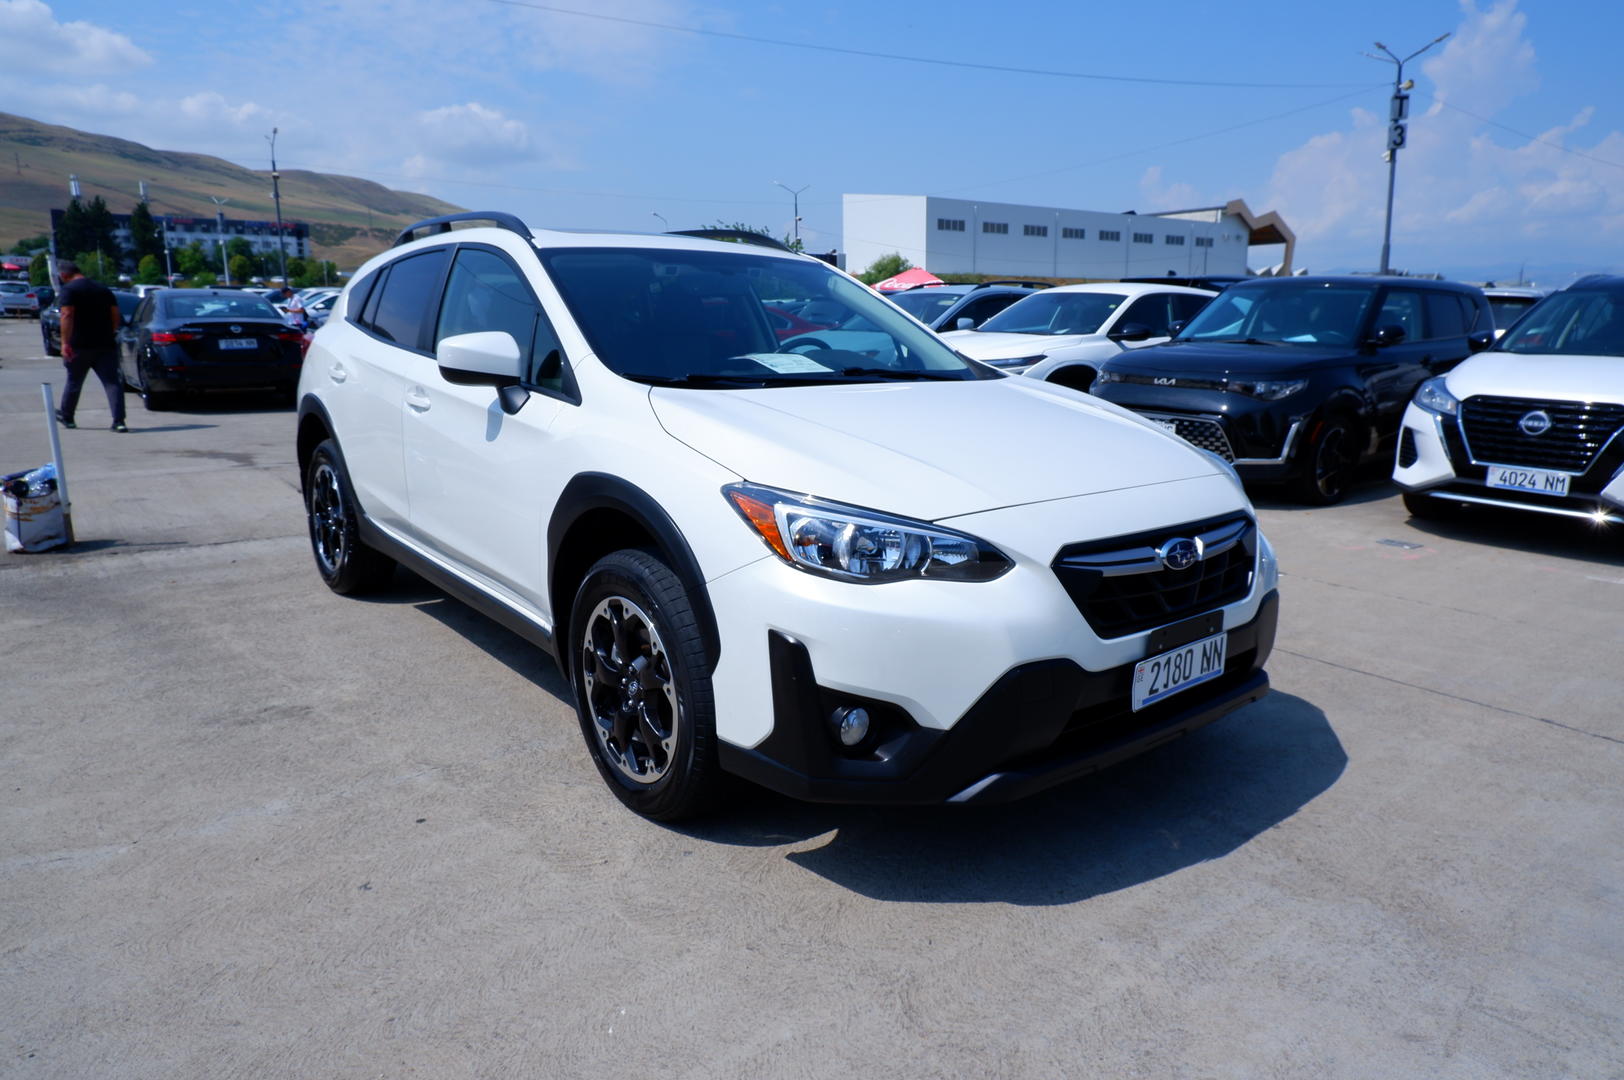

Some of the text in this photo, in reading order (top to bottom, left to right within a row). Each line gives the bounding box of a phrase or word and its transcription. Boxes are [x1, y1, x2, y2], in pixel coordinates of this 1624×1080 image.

[1395, 94, 1410, 118] T
[1393, 124, 1405, 147] 3
[1500, 471, 1566, 491] 4024 NM
[1149, 637, 1224, 696] 2180 NN
